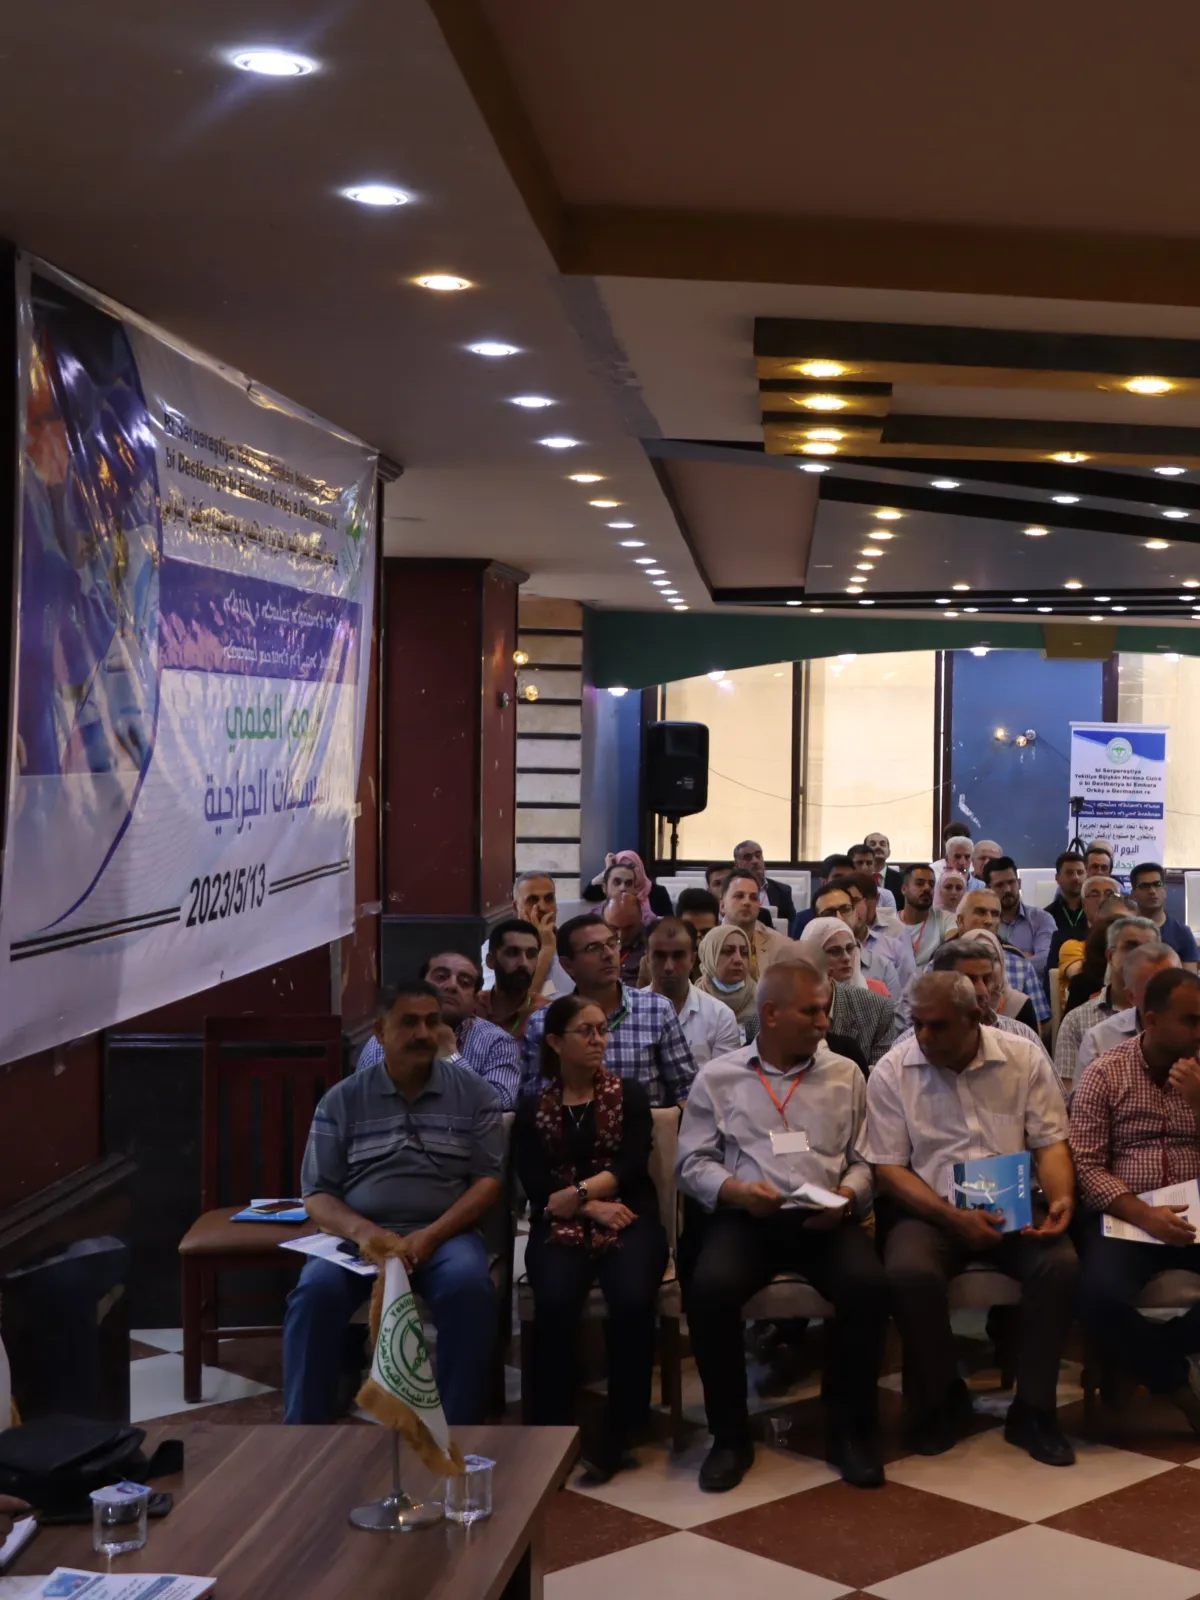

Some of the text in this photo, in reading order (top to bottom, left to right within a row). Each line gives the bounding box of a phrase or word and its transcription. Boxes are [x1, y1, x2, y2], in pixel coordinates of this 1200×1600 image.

[225, 692, 283, 754] العلمي
[204, 768, 268, 836] الجراحية
[1120, 844, 1139, 856] اليوم
[186, 863, 267, 927] 2023/5/13
